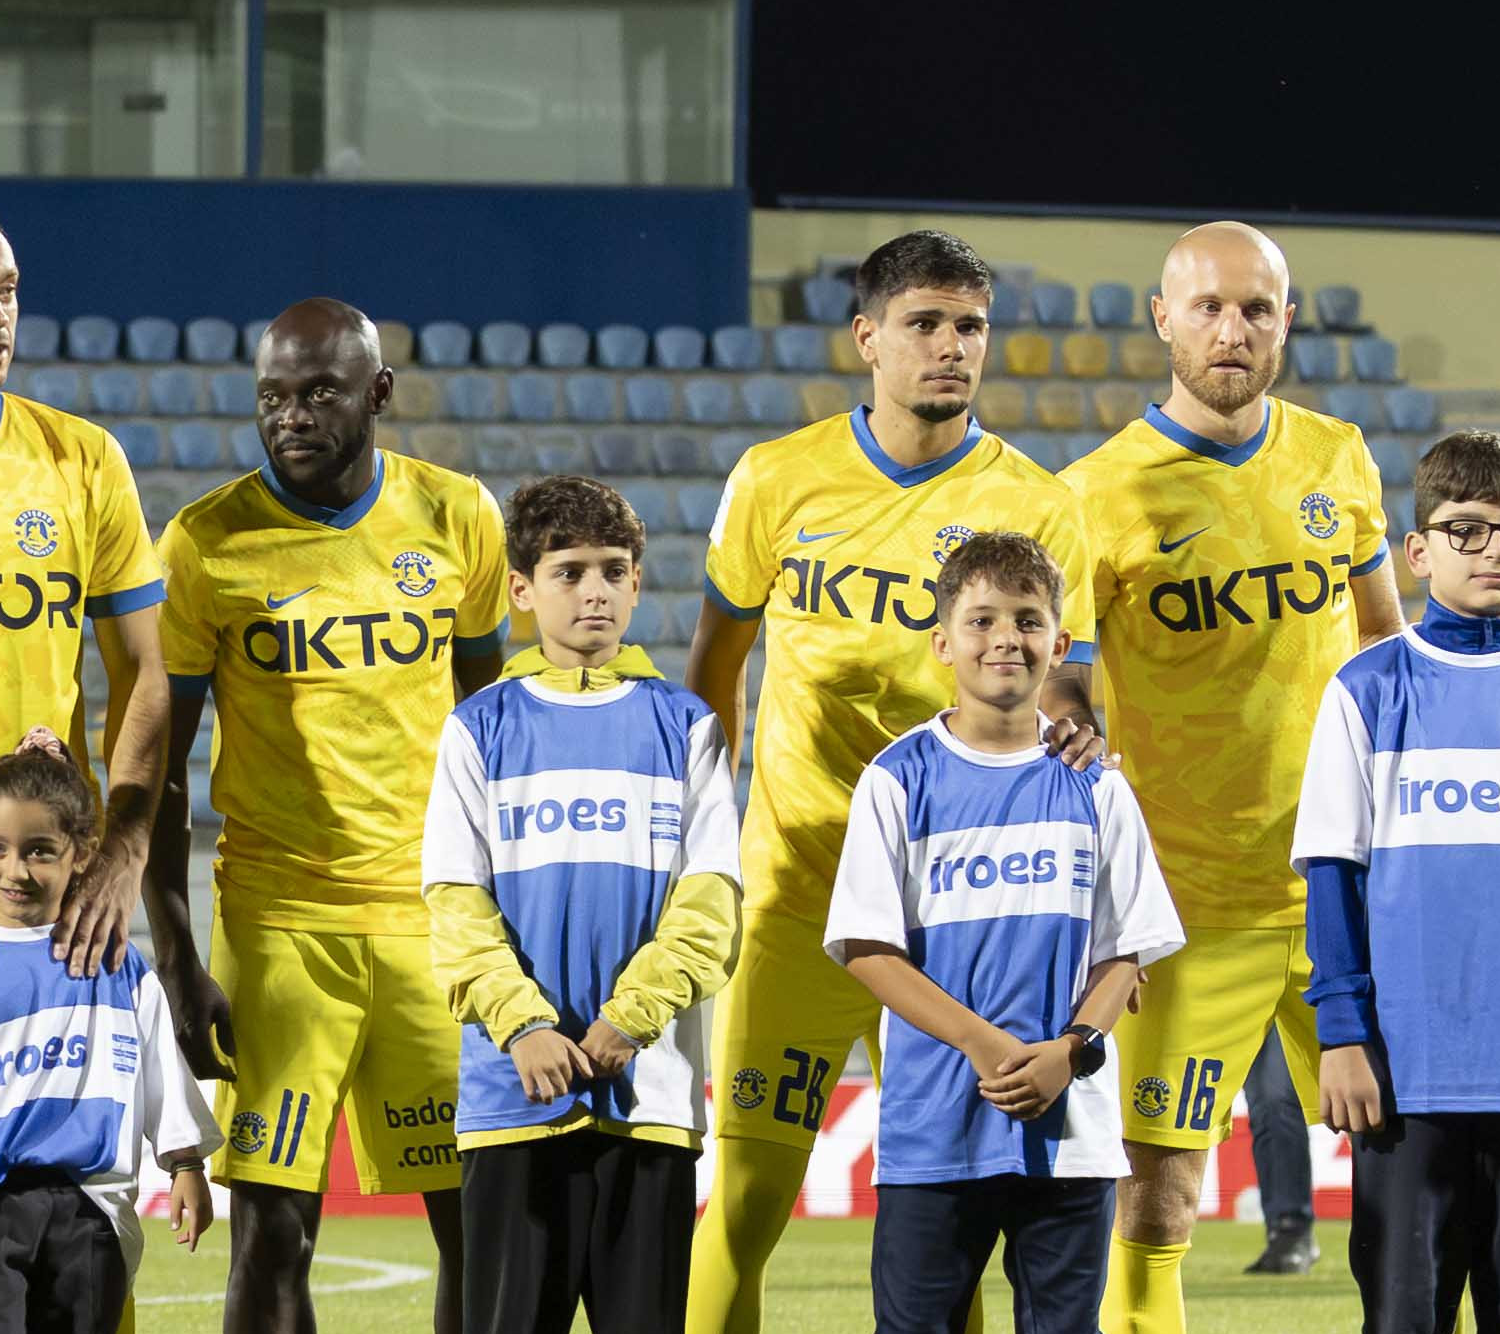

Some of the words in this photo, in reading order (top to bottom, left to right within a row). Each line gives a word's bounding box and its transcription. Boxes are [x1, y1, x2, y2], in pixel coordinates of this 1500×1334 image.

[497, 798, 627, 843] iroes
[930, 848, 1057, 894] iroes
[384, 1096, 456, 1129] bado
[1174, 1056, 1224, 1131] 16
[268, 1088, 311, 1167] 11
